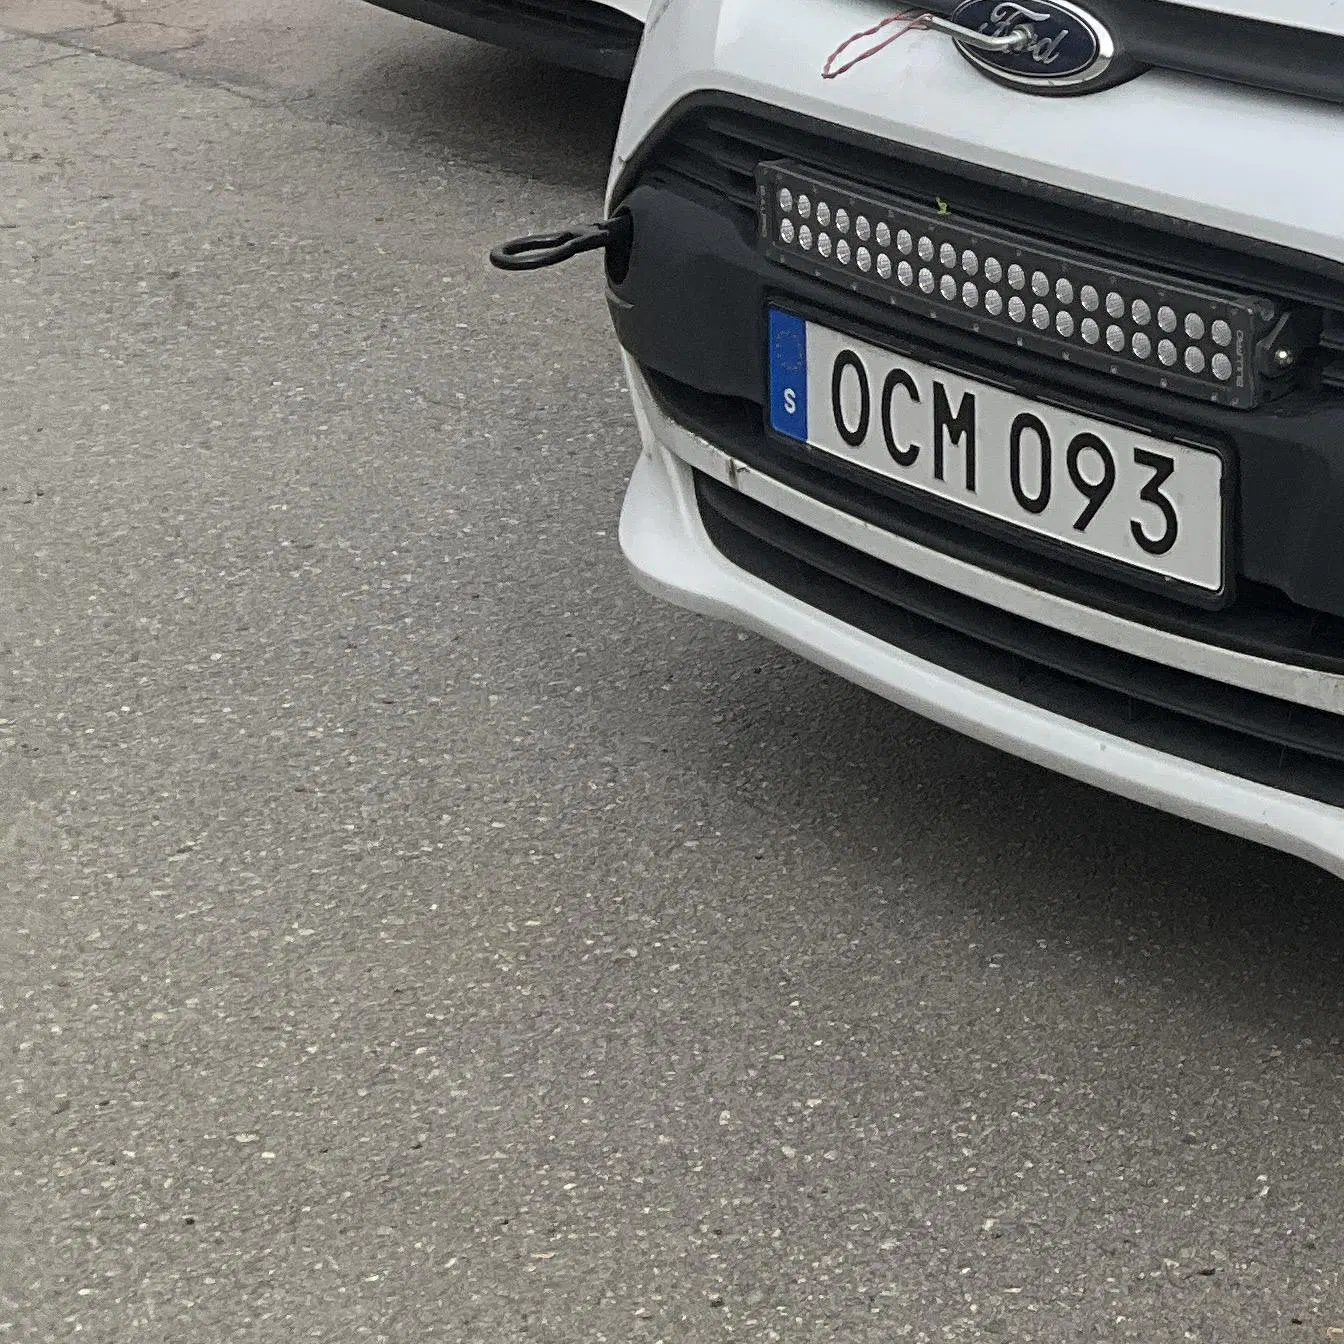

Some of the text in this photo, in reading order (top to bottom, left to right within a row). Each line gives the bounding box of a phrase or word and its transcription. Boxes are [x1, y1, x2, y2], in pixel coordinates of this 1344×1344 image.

[783, 387, 797, 414] S
[831, 349, 1179, 555] OCM 093
